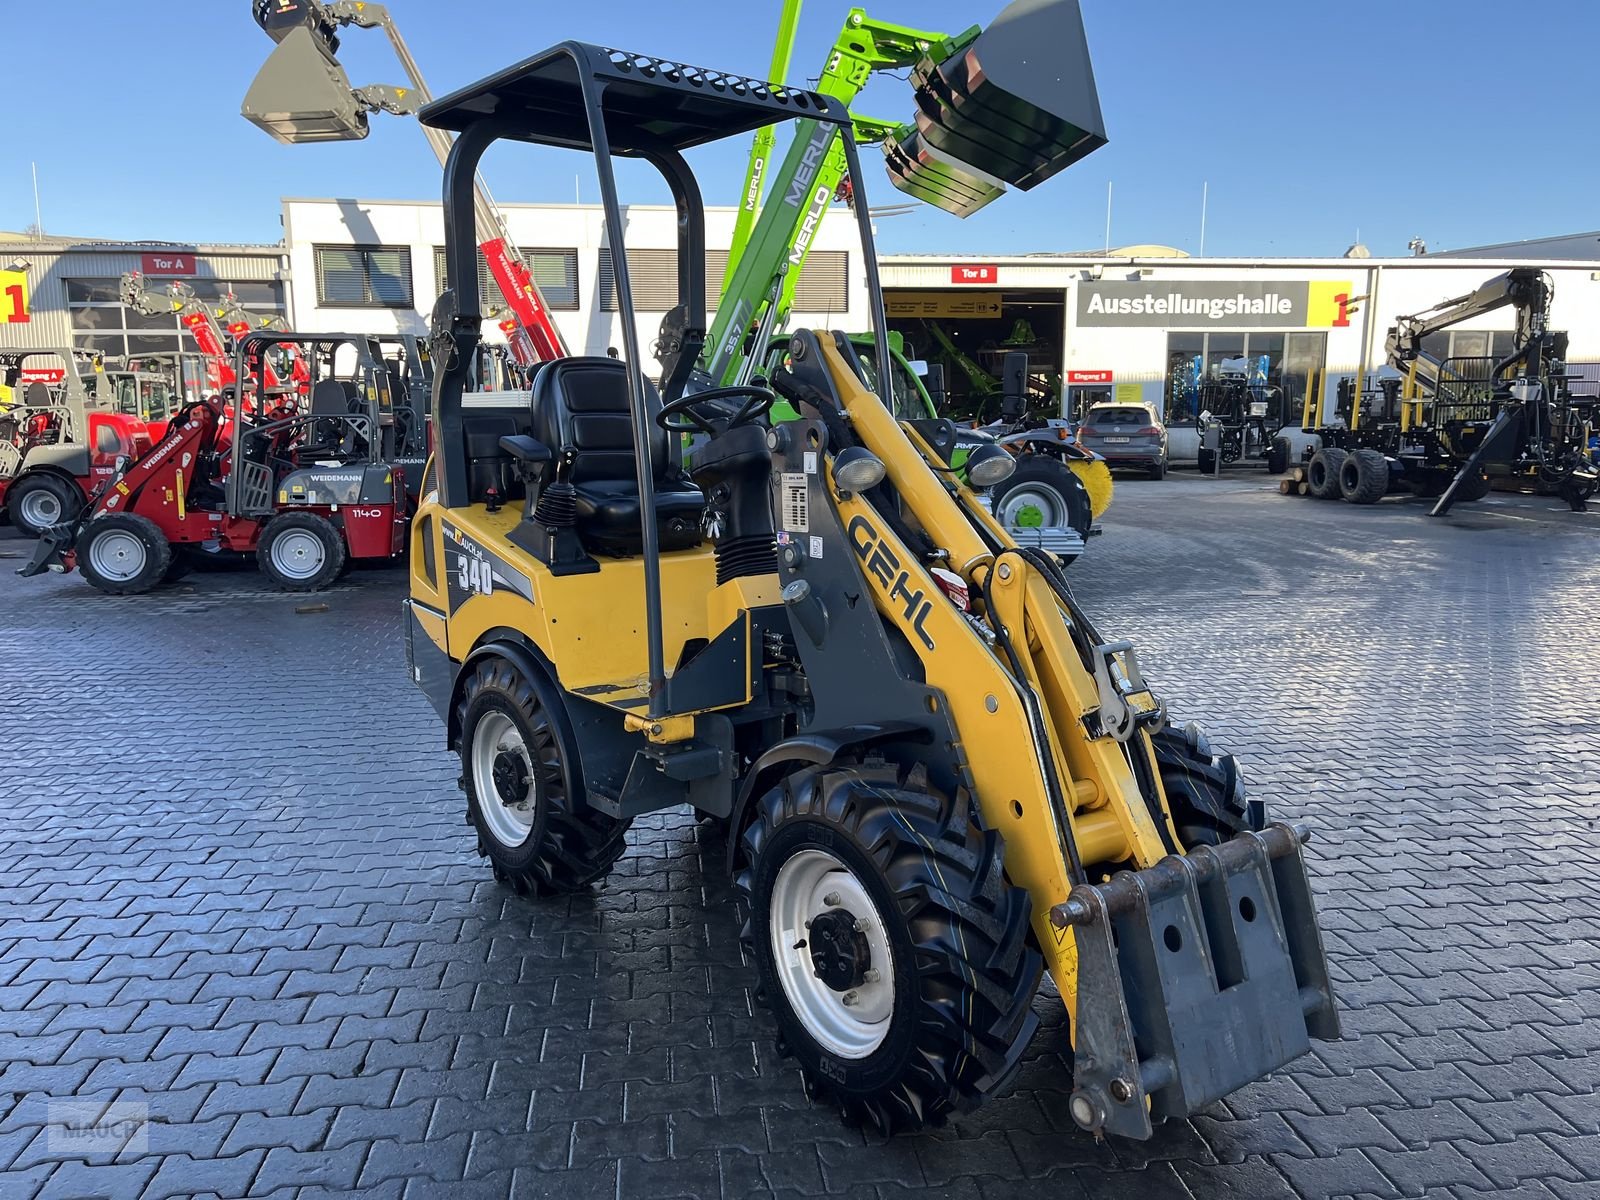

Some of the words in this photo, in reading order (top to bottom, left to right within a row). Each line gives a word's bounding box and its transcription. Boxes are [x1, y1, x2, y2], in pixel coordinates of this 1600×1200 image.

[784, 122, 834, 207] MERLO
[746, 158, 763, 211] MERLO
[789, 186, 830, 265] MERLO
[153, 258, 173, 269] Tor
[175, 258, 185, 269] A
[498, 253, 524, 299] WEIDEMANN
[962, 269, 978, 278] Tor
[980, 269, 988, 278] B
[5, 285, 31, 323] 1
[1087, 293, 1292, 319] Ausstellungshalle
[1332, 293, 1350, 327] 1
[725, 323, 742, 355] 35.7
[143, 434, 183, 470] WEIDEMANN
[352, 509, 382, 518] 1140
[458, 554, 493, 595] 340
[847, 514, 935, 651] GEHL
